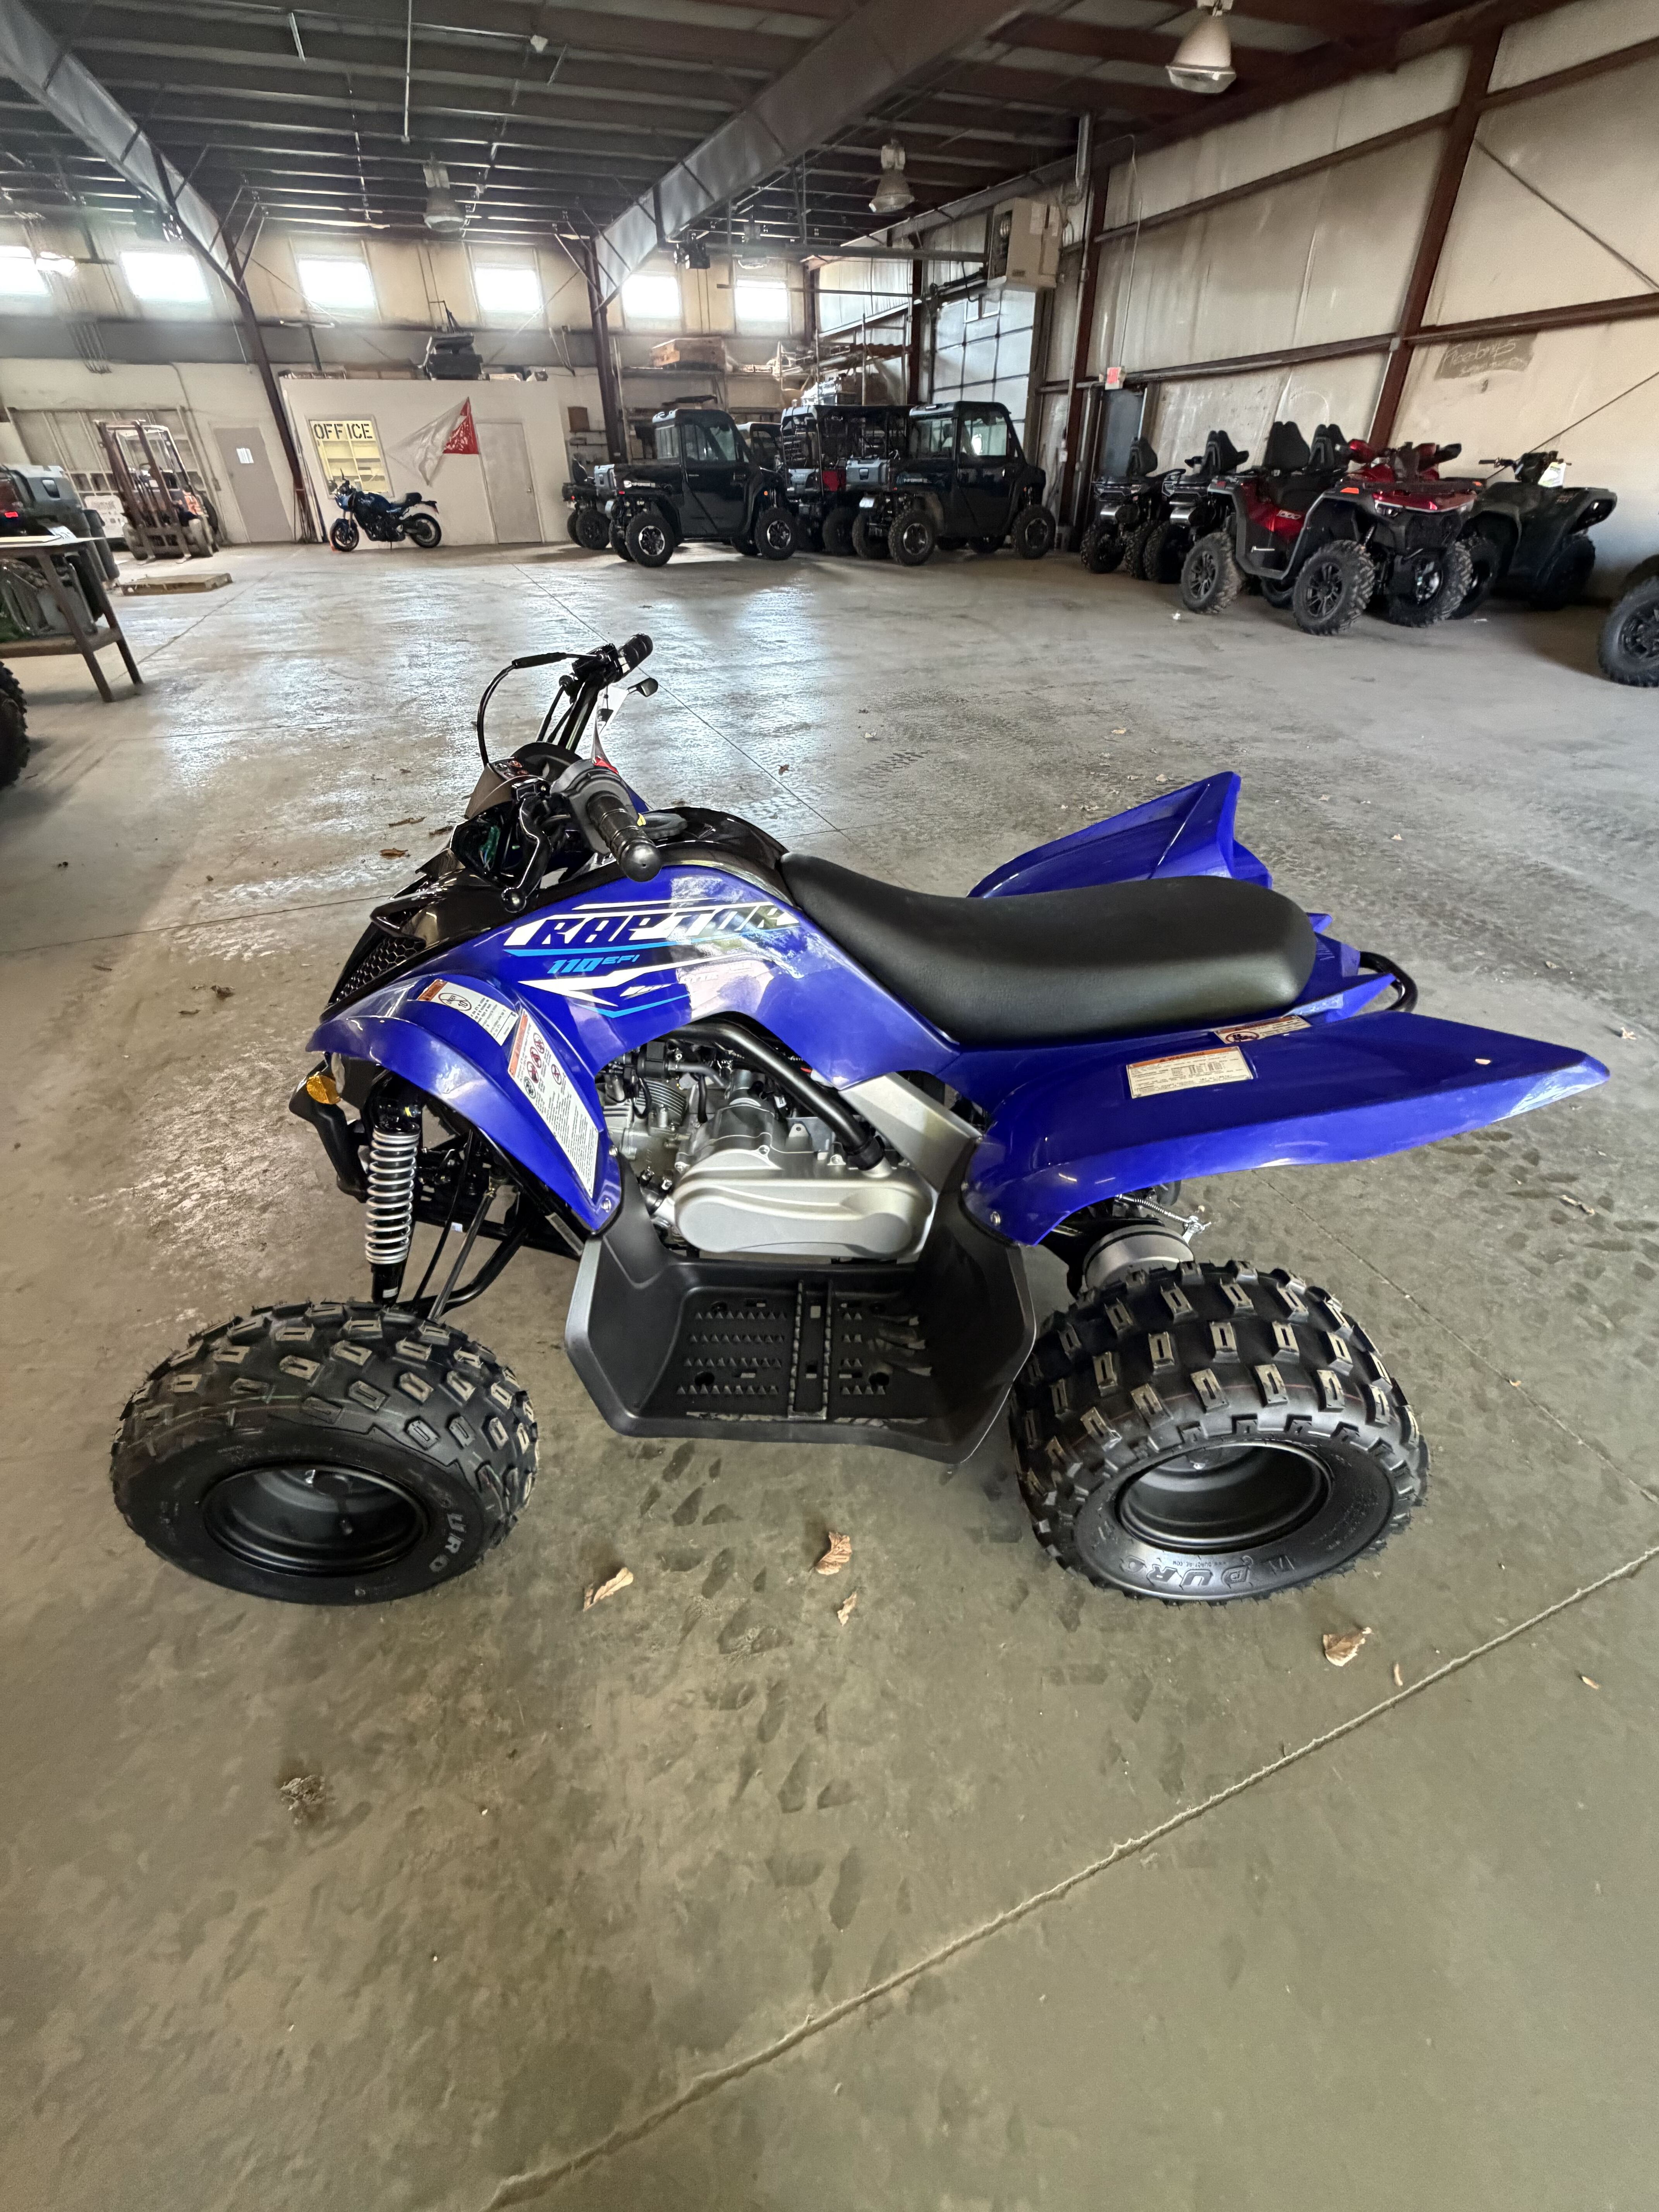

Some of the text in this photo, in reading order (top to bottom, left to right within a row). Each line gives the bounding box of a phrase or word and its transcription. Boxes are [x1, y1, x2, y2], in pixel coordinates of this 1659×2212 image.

[314, 424, 373, 439] OFFICE
[525, 905, 786, 945] RAPTOR
[547, 955, 640, 974] 110 EFI
[1120, 1555, 1253, 1587] DURO
